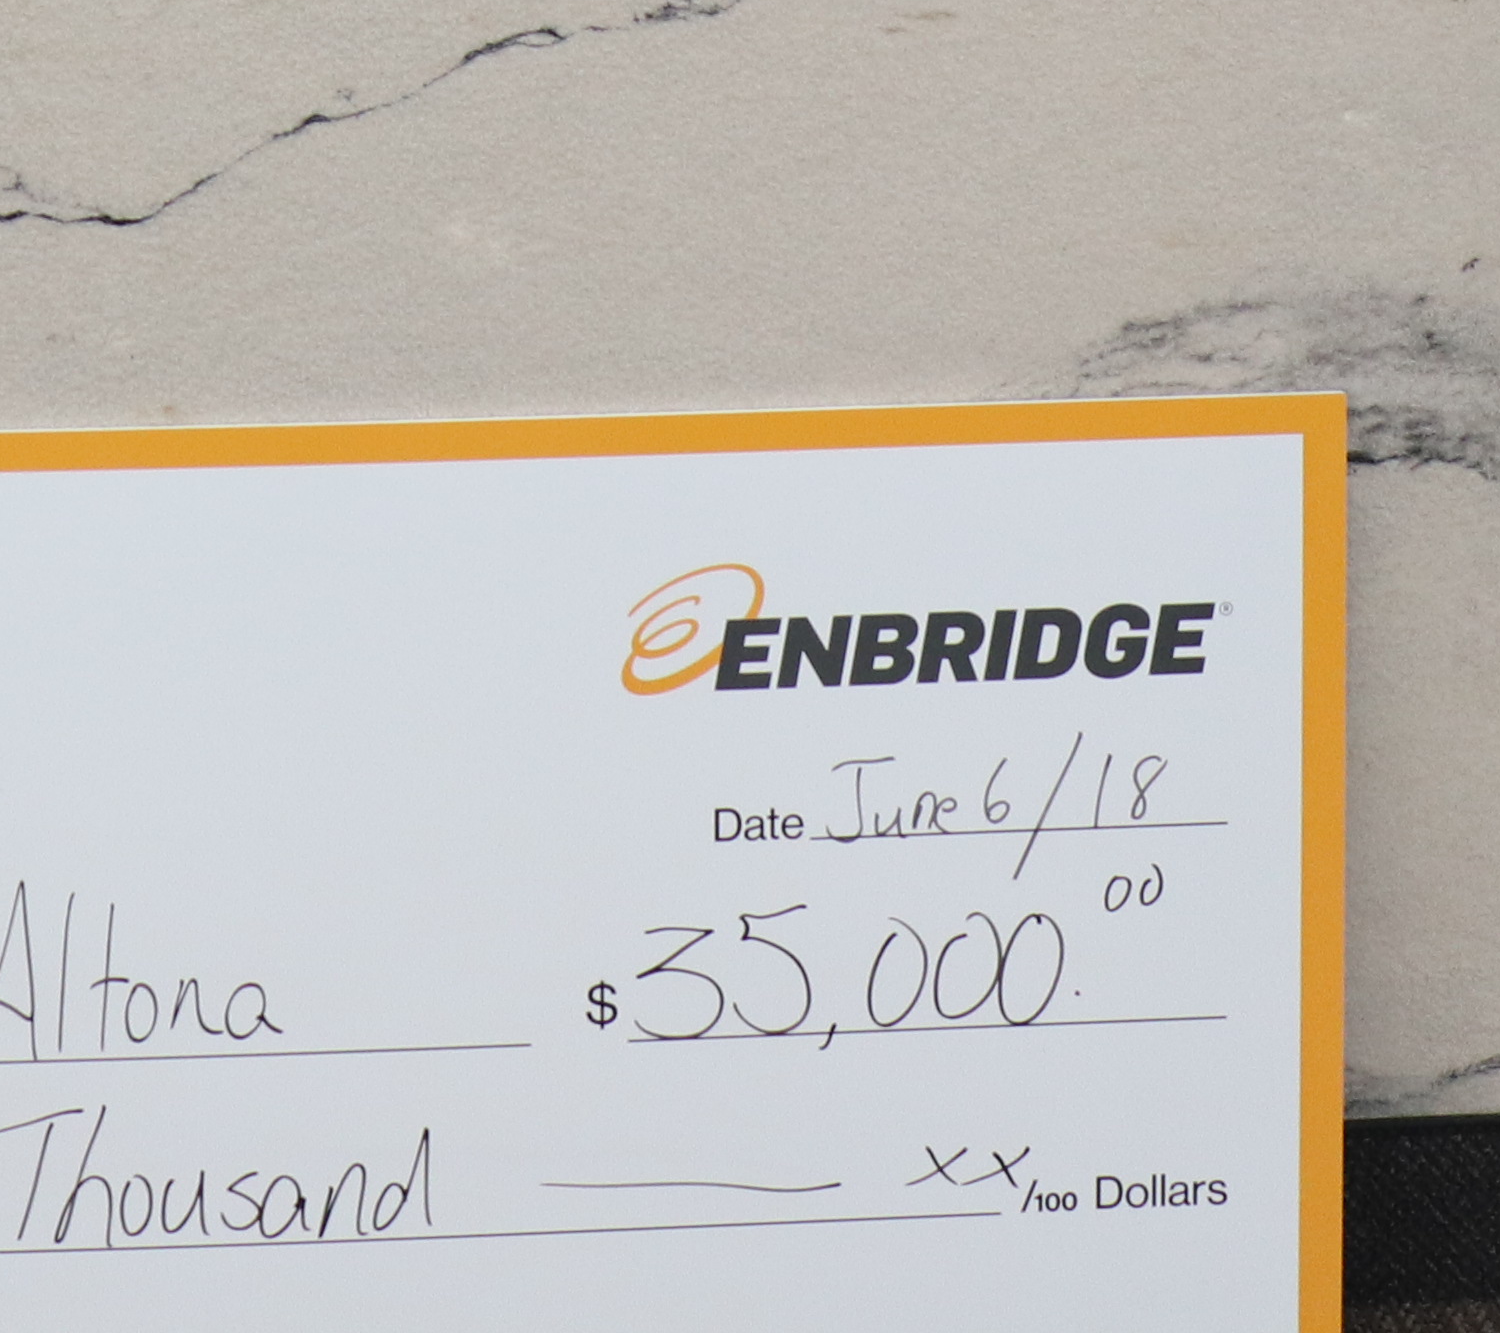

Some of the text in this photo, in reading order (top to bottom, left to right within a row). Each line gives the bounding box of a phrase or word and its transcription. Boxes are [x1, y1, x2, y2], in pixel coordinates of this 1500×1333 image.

[713, 601, 1217, 691] ENBRIDGE
[712, 807, 806, 844] Date
[825, 753, 959, 845] June
[1094, 1172, 1230, 1212] Dollars
